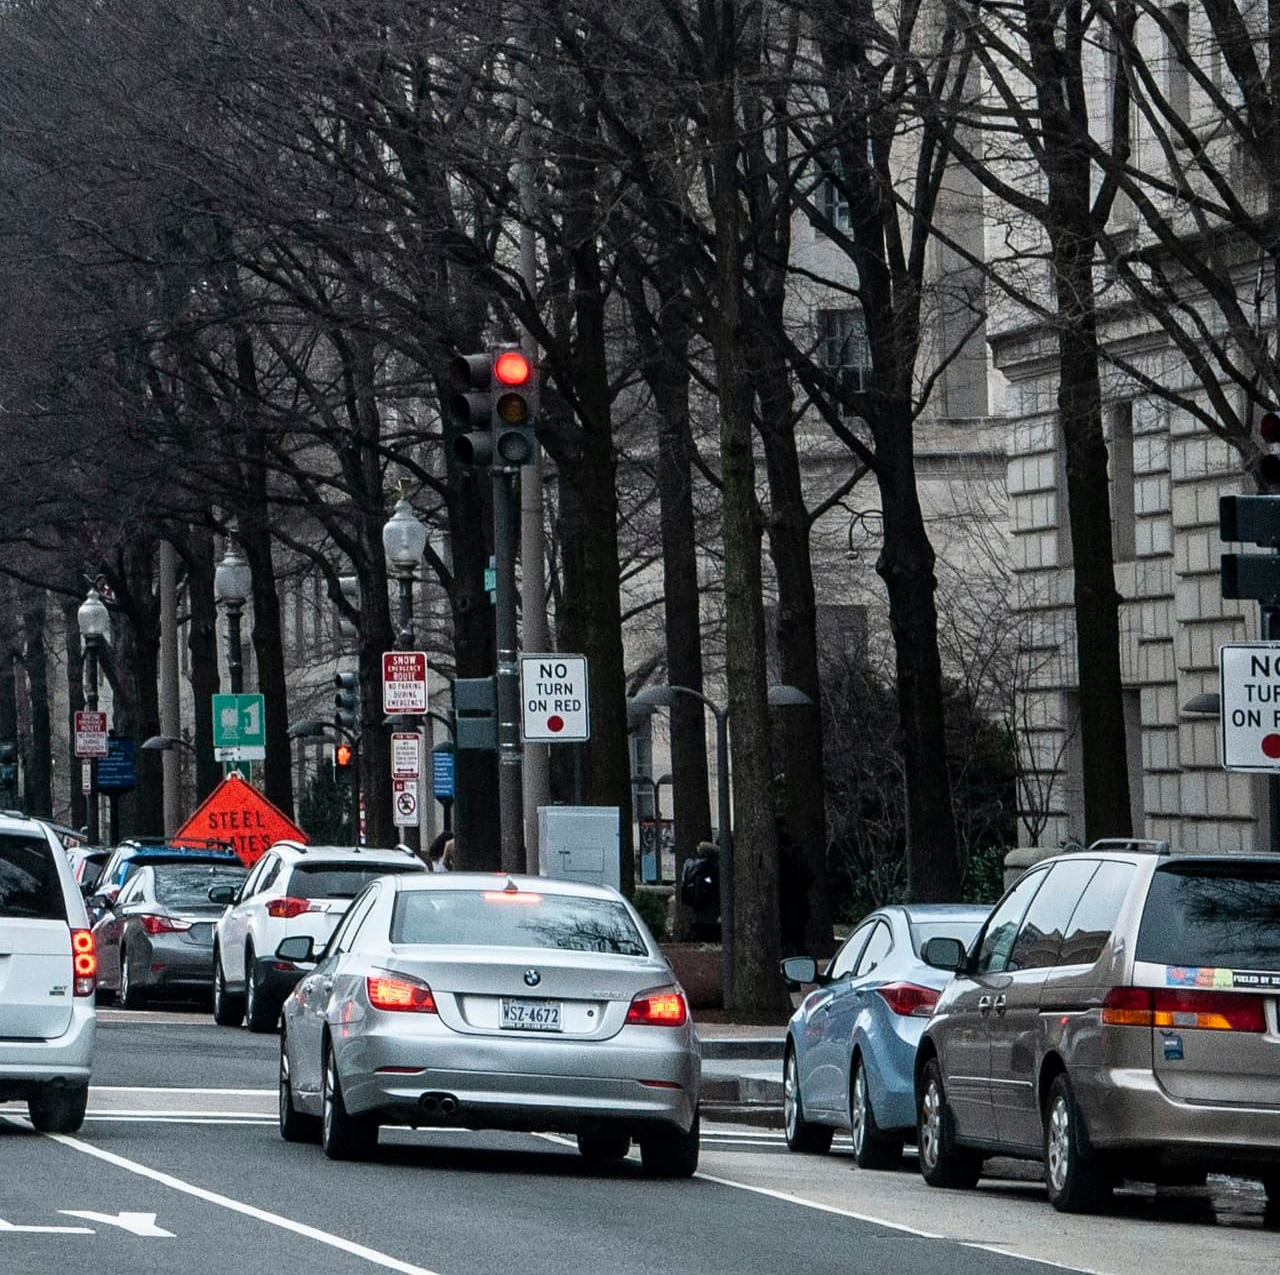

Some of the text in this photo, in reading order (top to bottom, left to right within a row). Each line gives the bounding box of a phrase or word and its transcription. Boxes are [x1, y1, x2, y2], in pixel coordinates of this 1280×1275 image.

[393, 655, 416, 665] SNOW
[393, 672, 415, 680] ROUTE
[540, 663, 567, 679] NO
[536, 683, 573, 695] TURN
[528, 699, 582, 712] ON RED
[1232, 709, 1261, 727] ON
[208, 810, 266, 830] STEEL
[1233, 974, 1260, 984] FUELED
[1260, 976, 1270, 984] BY
[503, 1005, 559, 1023] WSZ-4672
